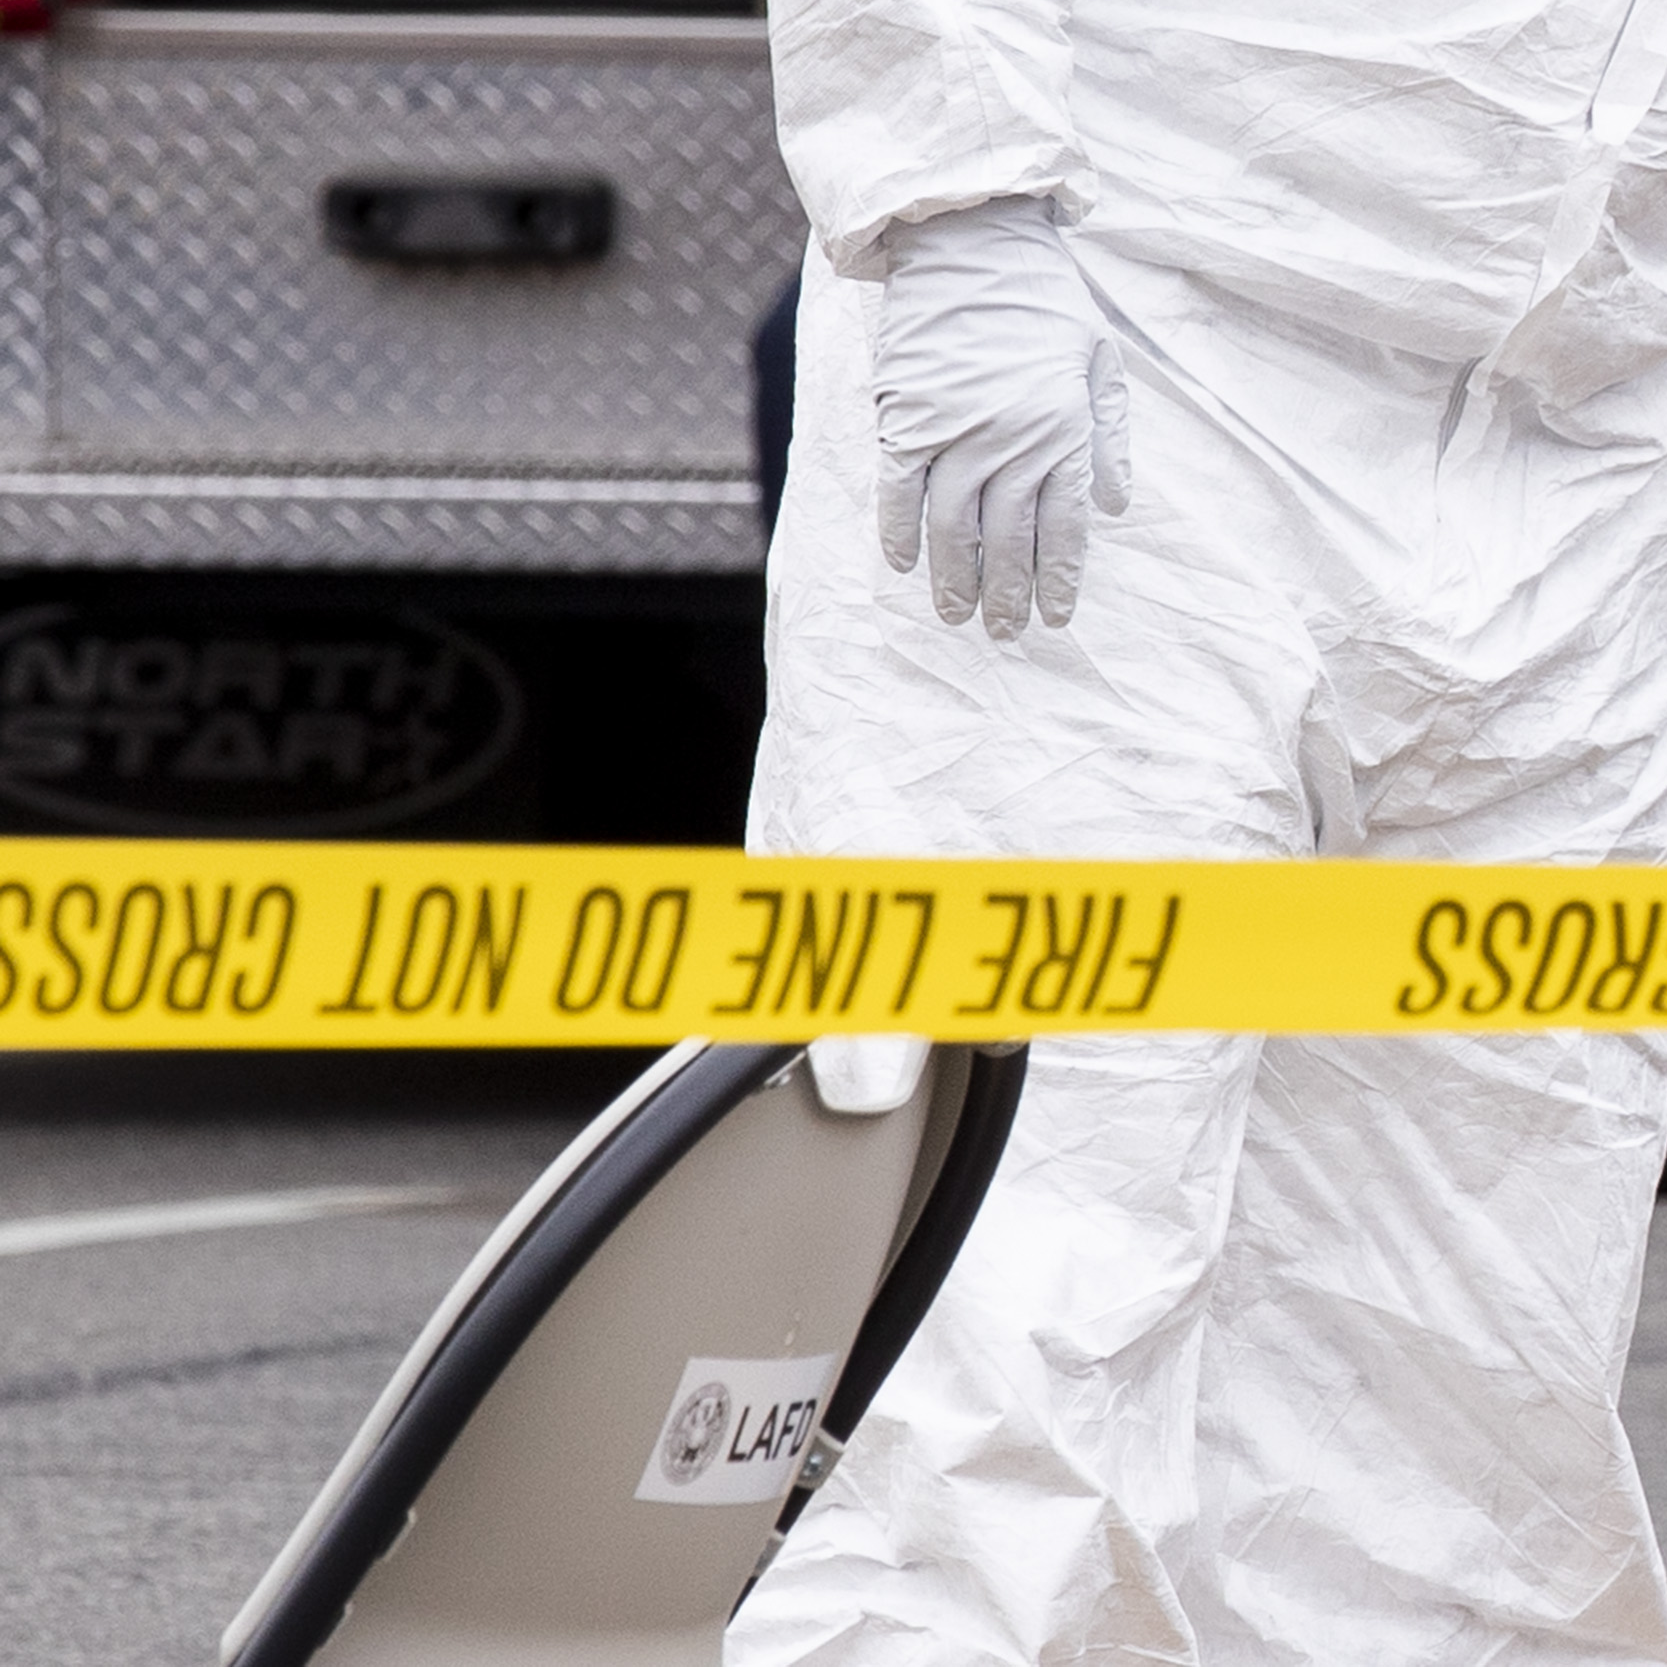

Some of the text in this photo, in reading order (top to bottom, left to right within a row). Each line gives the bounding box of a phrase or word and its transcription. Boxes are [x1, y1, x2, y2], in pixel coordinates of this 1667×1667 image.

[316, 882, 528, 1015] NOT
[555, 884, 693, 1013] DO
[710, 887, 938, 1015] LINE
[951, 892, 1184, 1016] FIRE
[727, 1397, 818, 1464] LAFD
